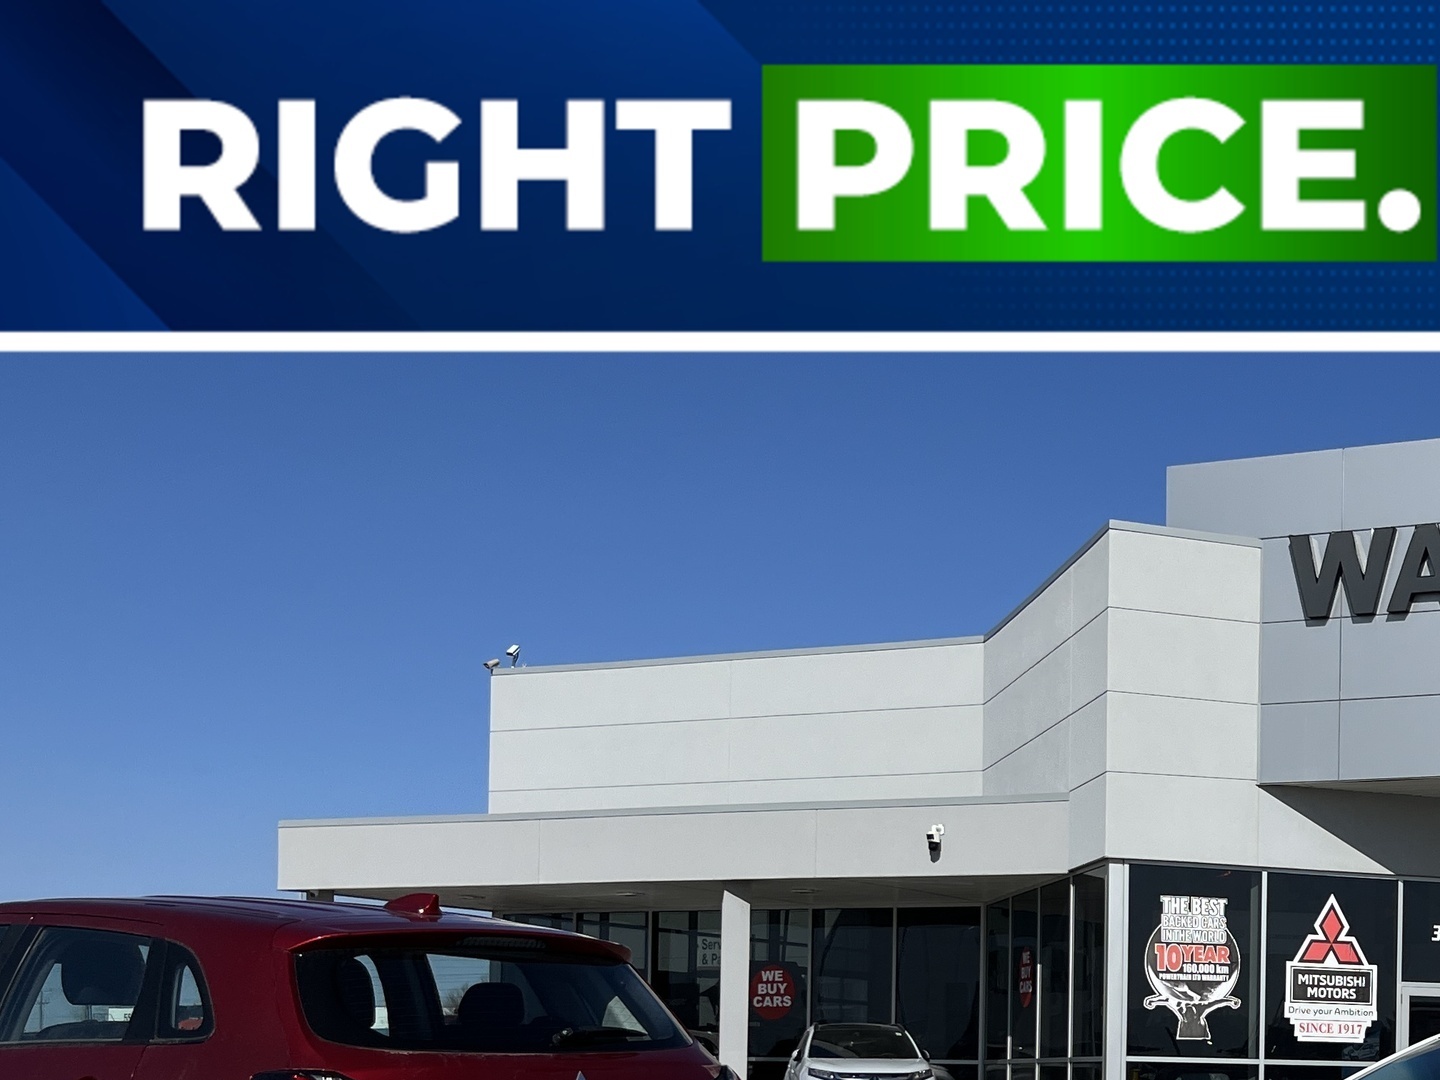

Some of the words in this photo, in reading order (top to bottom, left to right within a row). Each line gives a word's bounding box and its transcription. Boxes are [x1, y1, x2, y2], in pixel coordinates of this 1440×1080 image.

[1161, 896, 1189, 914] THE
[1191, 897, 1227, 916] BEST
[1162, 915, 1200, 928] BACKED
[1201, 916, 1227, 929] CARS
[1163, 929, 1172, 942] IN
[1172, 929, 1191, 942] THE
[1192, 930, 1227, 943] WORLD
[1155, 943, 1182, 972] 10
[1181, 945, 1230, 963] YEAR
[1216, 964, 1229, 974] km
[761, 970, 783, 982] WE
[1298, 974, 1365, 987] MITSUBISHI
[758, 983, 787, 994] BUY
[1307, 987, 1356, 999] MOTORS
[753, 996, 792, 1008] CARS
[1289, 1006, 1311, 1014] Drive
[1314, 1008, 1332, 1016] your
[1335, 1008, 1373, 1016] Ambition
[1299, 1023, 1334, 1033] SINCE
[1338, 1024, 1362, 1034] 1917
